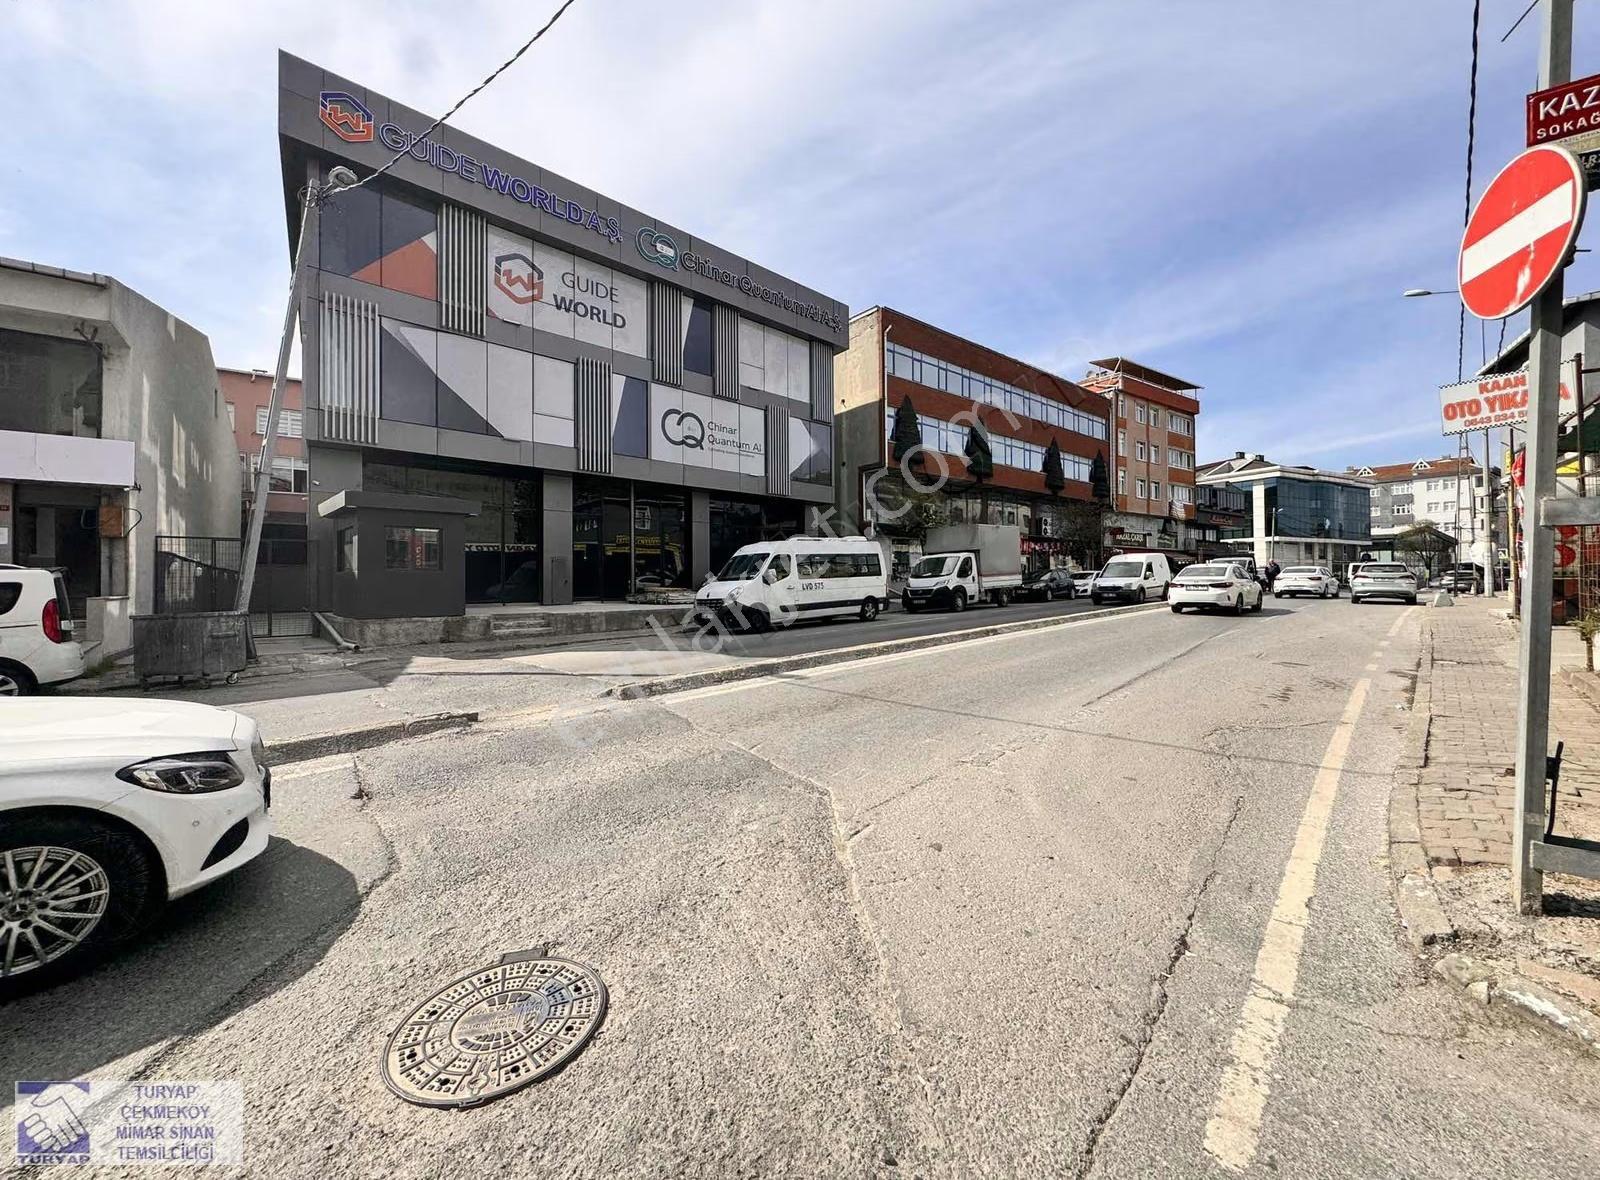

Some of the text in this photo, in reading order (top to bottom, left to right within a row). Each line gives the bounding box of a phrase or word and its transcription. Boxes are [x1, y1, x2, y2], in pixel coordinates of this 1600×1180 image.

[379, 122, 478, 183] GUIDE
[482, 164, 583, 227] WORLD
[561, 271, 618, 303] GUIDE
[681, 250, 739, 289] Chinar
[739, 275, 806, 318] Quantum
[553, 293, 627, 329] WORLD
[1478, 374, 1527, 395] KAAN
[1443, 397, 1482, 421] OTO
[707, 421, 738, 435] Chinar
[707, 433, 750, 451] Quantum
